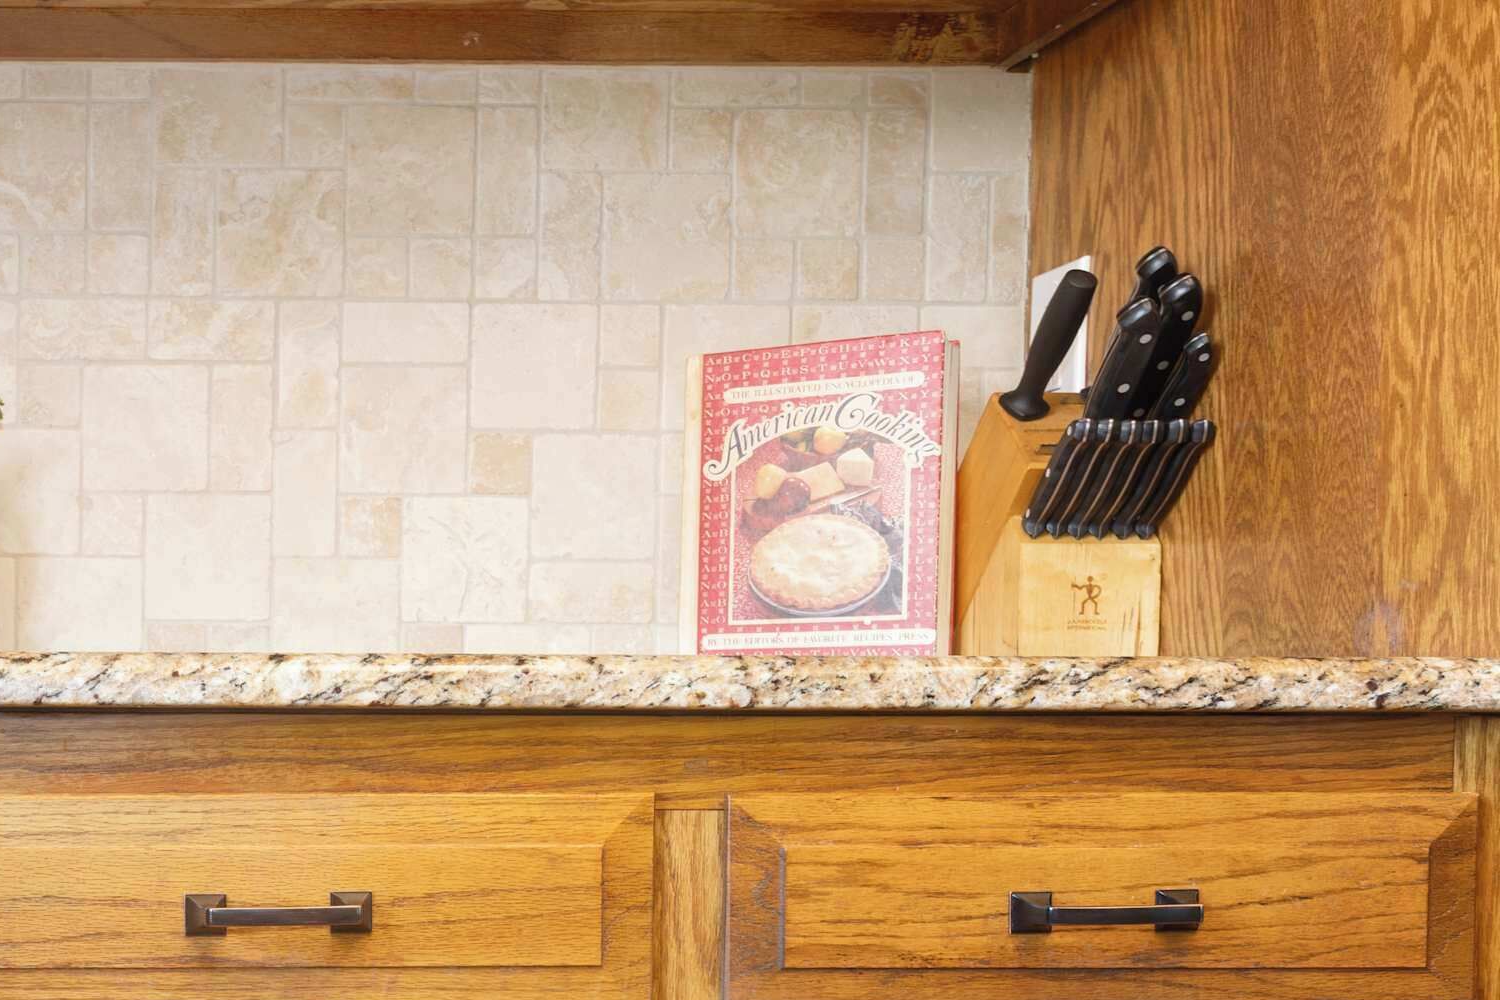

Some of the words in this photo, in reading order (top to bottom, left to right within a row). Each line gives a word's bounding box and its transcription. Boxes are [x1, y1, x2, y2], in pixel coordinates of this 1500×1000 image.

[731, 390, 749, 400] THE
[753, 383, 822, 398] ILLUSTRATED
[824, 376, 900, 391] ENCYCLOPEDIA
[902, 375, 916, 385] OF
[708, 402, 832, 476] American
[834, 392, 939, 464] Cooking
[744, 634, 784, 645] EDITORS
[803, 633, 847, 643] FAVORITE
[853, 632, 893, 642] RECIPES
[899, 630, 930, 640] PRESS
